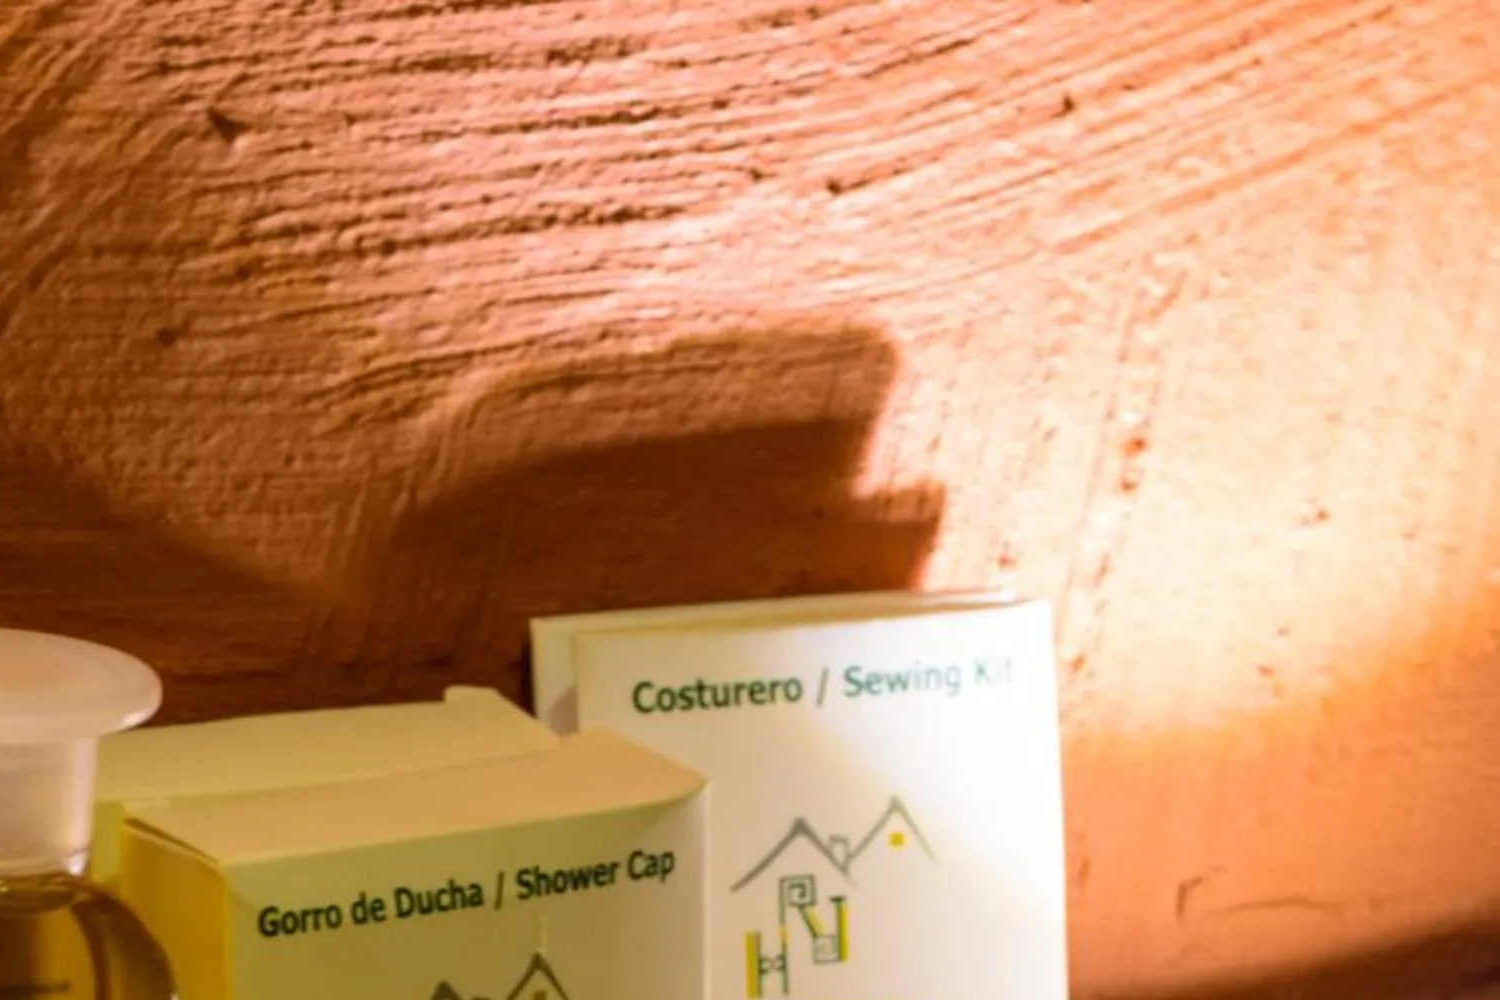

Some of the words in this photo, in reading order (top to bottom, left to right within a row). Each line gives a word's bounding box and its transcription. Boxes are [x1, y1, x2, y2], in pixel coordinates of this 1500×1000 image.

[631, 677, 802, 714] Costurero
[817, 668, 829, 707] /
[843, 663, 962, 698] Sewing
[974, 655, 1014, 687] Kt
[258, 904, 342, 939] Gorro
[351, 892, 386, 926] de
[395, 878, 484, 919] Ducha
[493, 870, 505, 911] /
[516, 858, 619, 899] Shower
[628, 847, 676, 884] Cap
